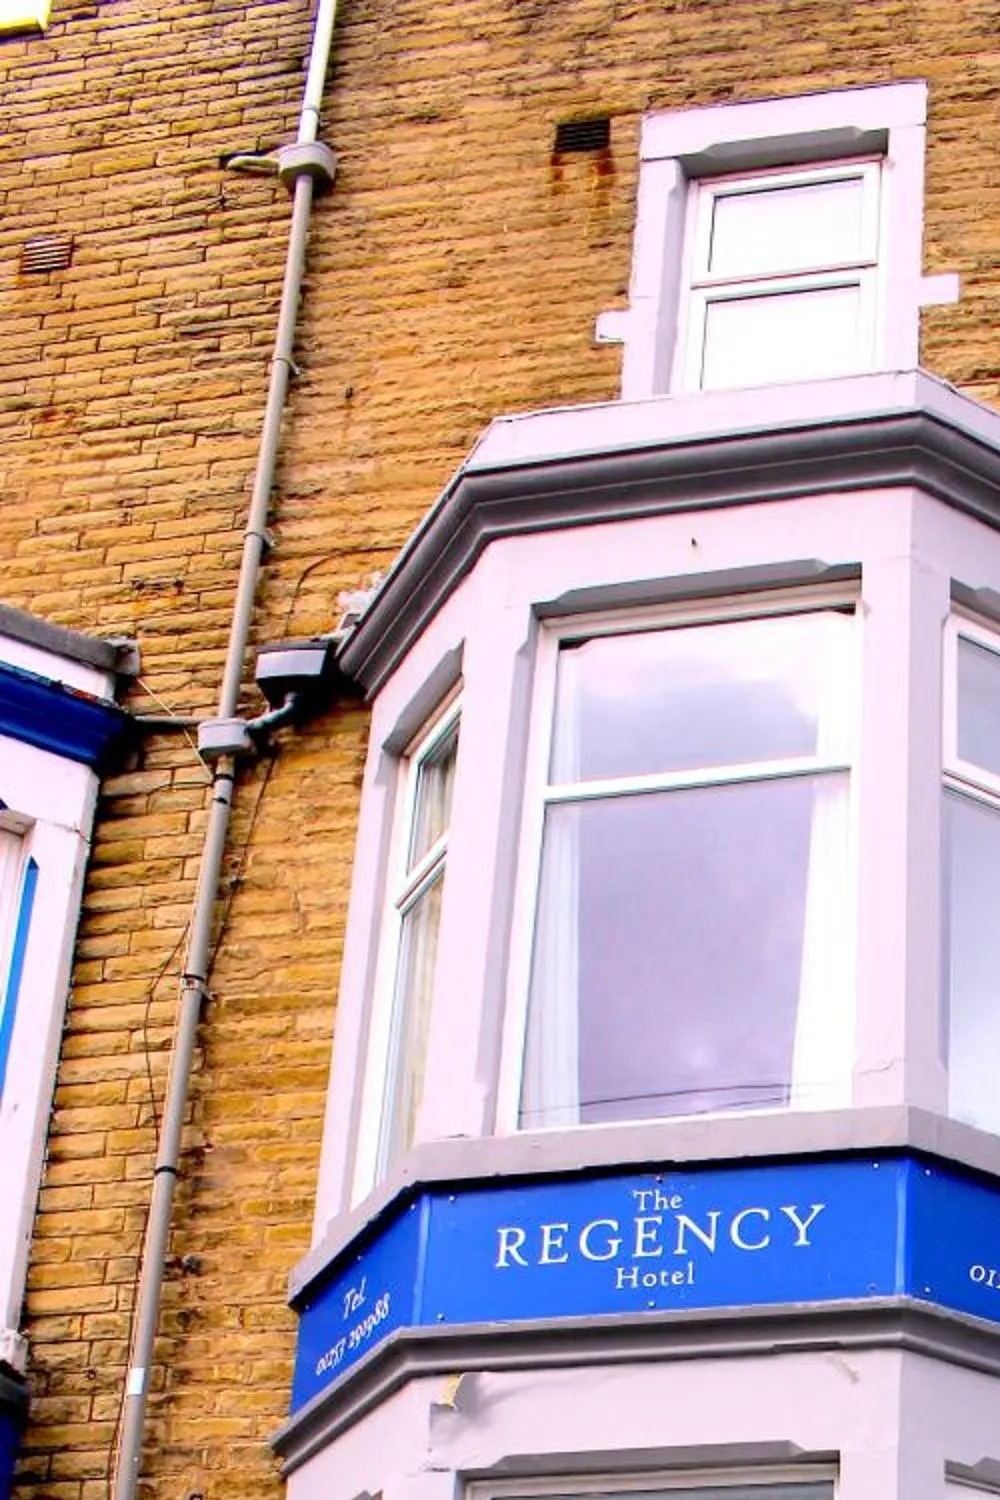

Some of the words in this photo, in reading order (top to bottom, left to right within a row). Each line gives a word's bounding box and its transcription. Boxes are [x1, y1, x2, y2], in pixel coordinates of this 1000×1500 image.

[632, 1188, 683, 1212] The
[494, 1202, 826, 1269] REGENCY
[614, 1262, 695, 1290] Hotel
